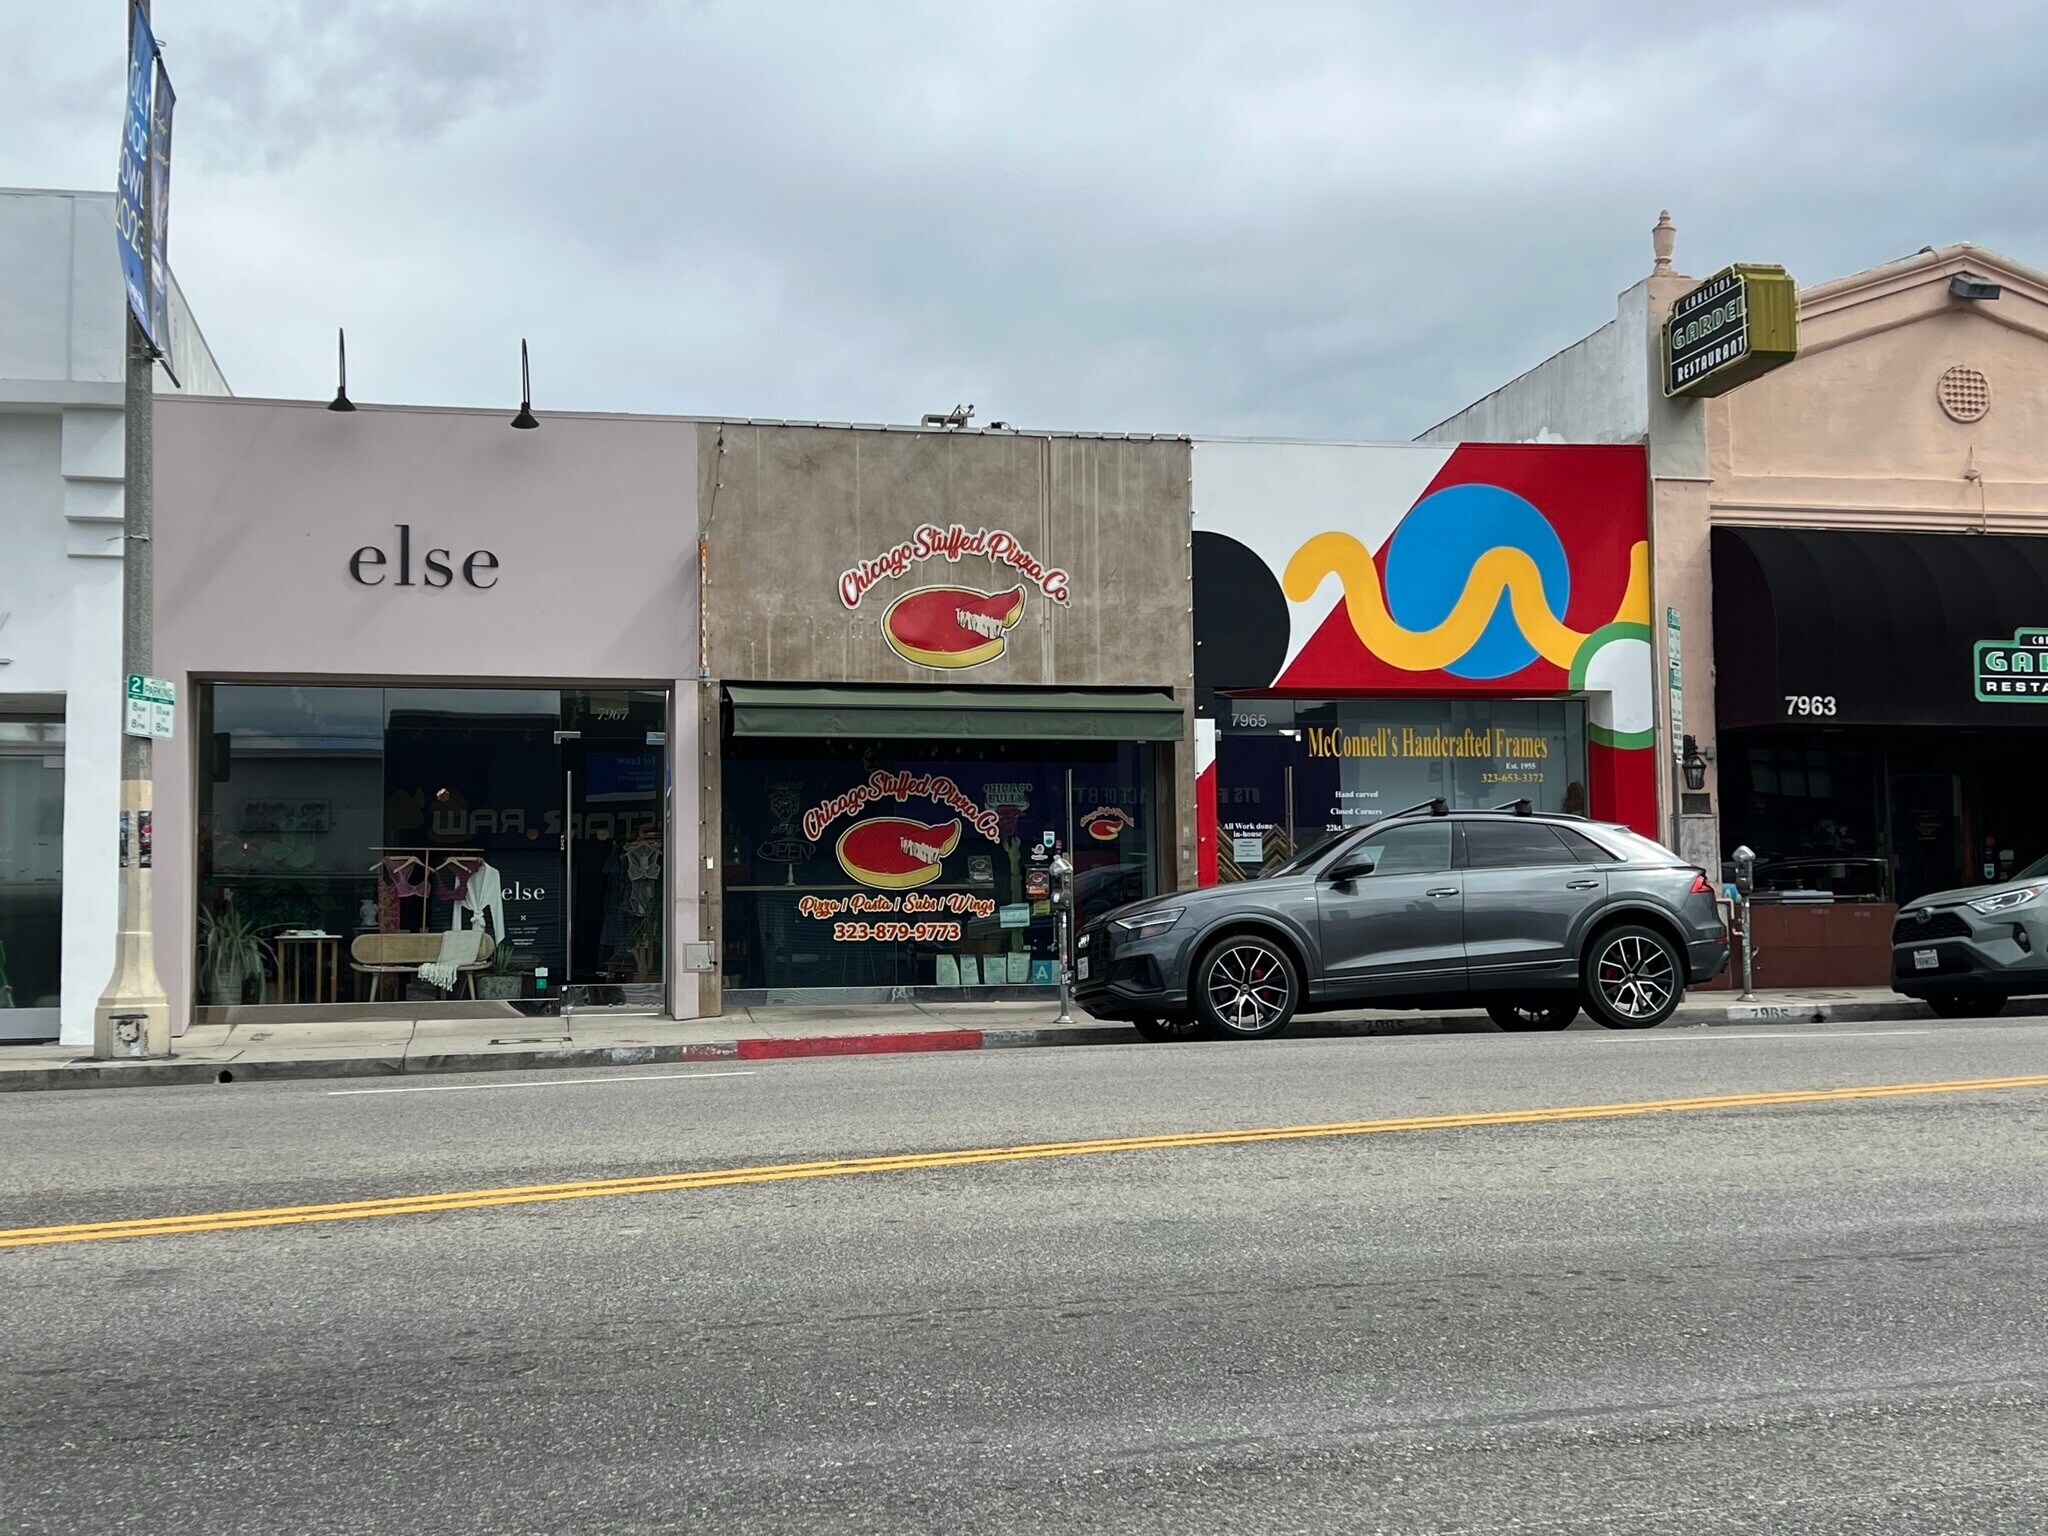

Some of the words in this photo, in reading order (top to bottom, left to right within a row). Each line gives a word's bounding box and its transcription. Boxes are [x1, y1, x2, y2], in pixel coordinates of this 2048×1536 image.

[1685, 276, 1731, 310] CARLITOS
[1672, 295, 1744, 350] GARDEL
[1677, 335, 1744, 383] RESTAURANT
[349, 524, 499, 589] else
[839, 541, 911, 609] Chicago
[914, 523, 987, 562] Stuffed
[988, 529, 1044, 582] Pizza
[131, 677, 141, 692] 2
[145, 685, 173, 699] PARKING
[597, 707, 629, 721] 7967
[1784, 695, 1837, 716] 7963
[1230, 713, 1267, 728] 7965
[1308, 727, 1398, 758] McConnell's
[1402, 728, 1491, 759] Handcrafted
[1495, 728, 1548, 759] Frames
[1505, 762, 1519, 770] Est.
[1520, 762, 1536, 770] 1955
[983, 783, 1033, 793] CHICAGO
[1481, 773, 1545, 784] 323-653-3372
[803, 787, 868, 842] Chicago
[868, 770, 931, 802] Stuffed
[931, 776, 980, 823] Pizza
[975, 810, 1000, 843] Co.
[1330, 807, 1353, 815] Closed
[1355, 807, 1383, 815] Corners
[761, 842, 811, 860] OPEN
[502, 881, 545, 901] else
[799, 894, 840, 920] Pizza
[850, 893, 893, 917] Pasta
[903, 892, 937, 913] Subs
[947, 893, 995, 919] Wings
[833, 921, 961, 942] 323-879-9773
[1037, 965, 1048, 980] A
[1750, 1007, 1789, 1020] 7965
